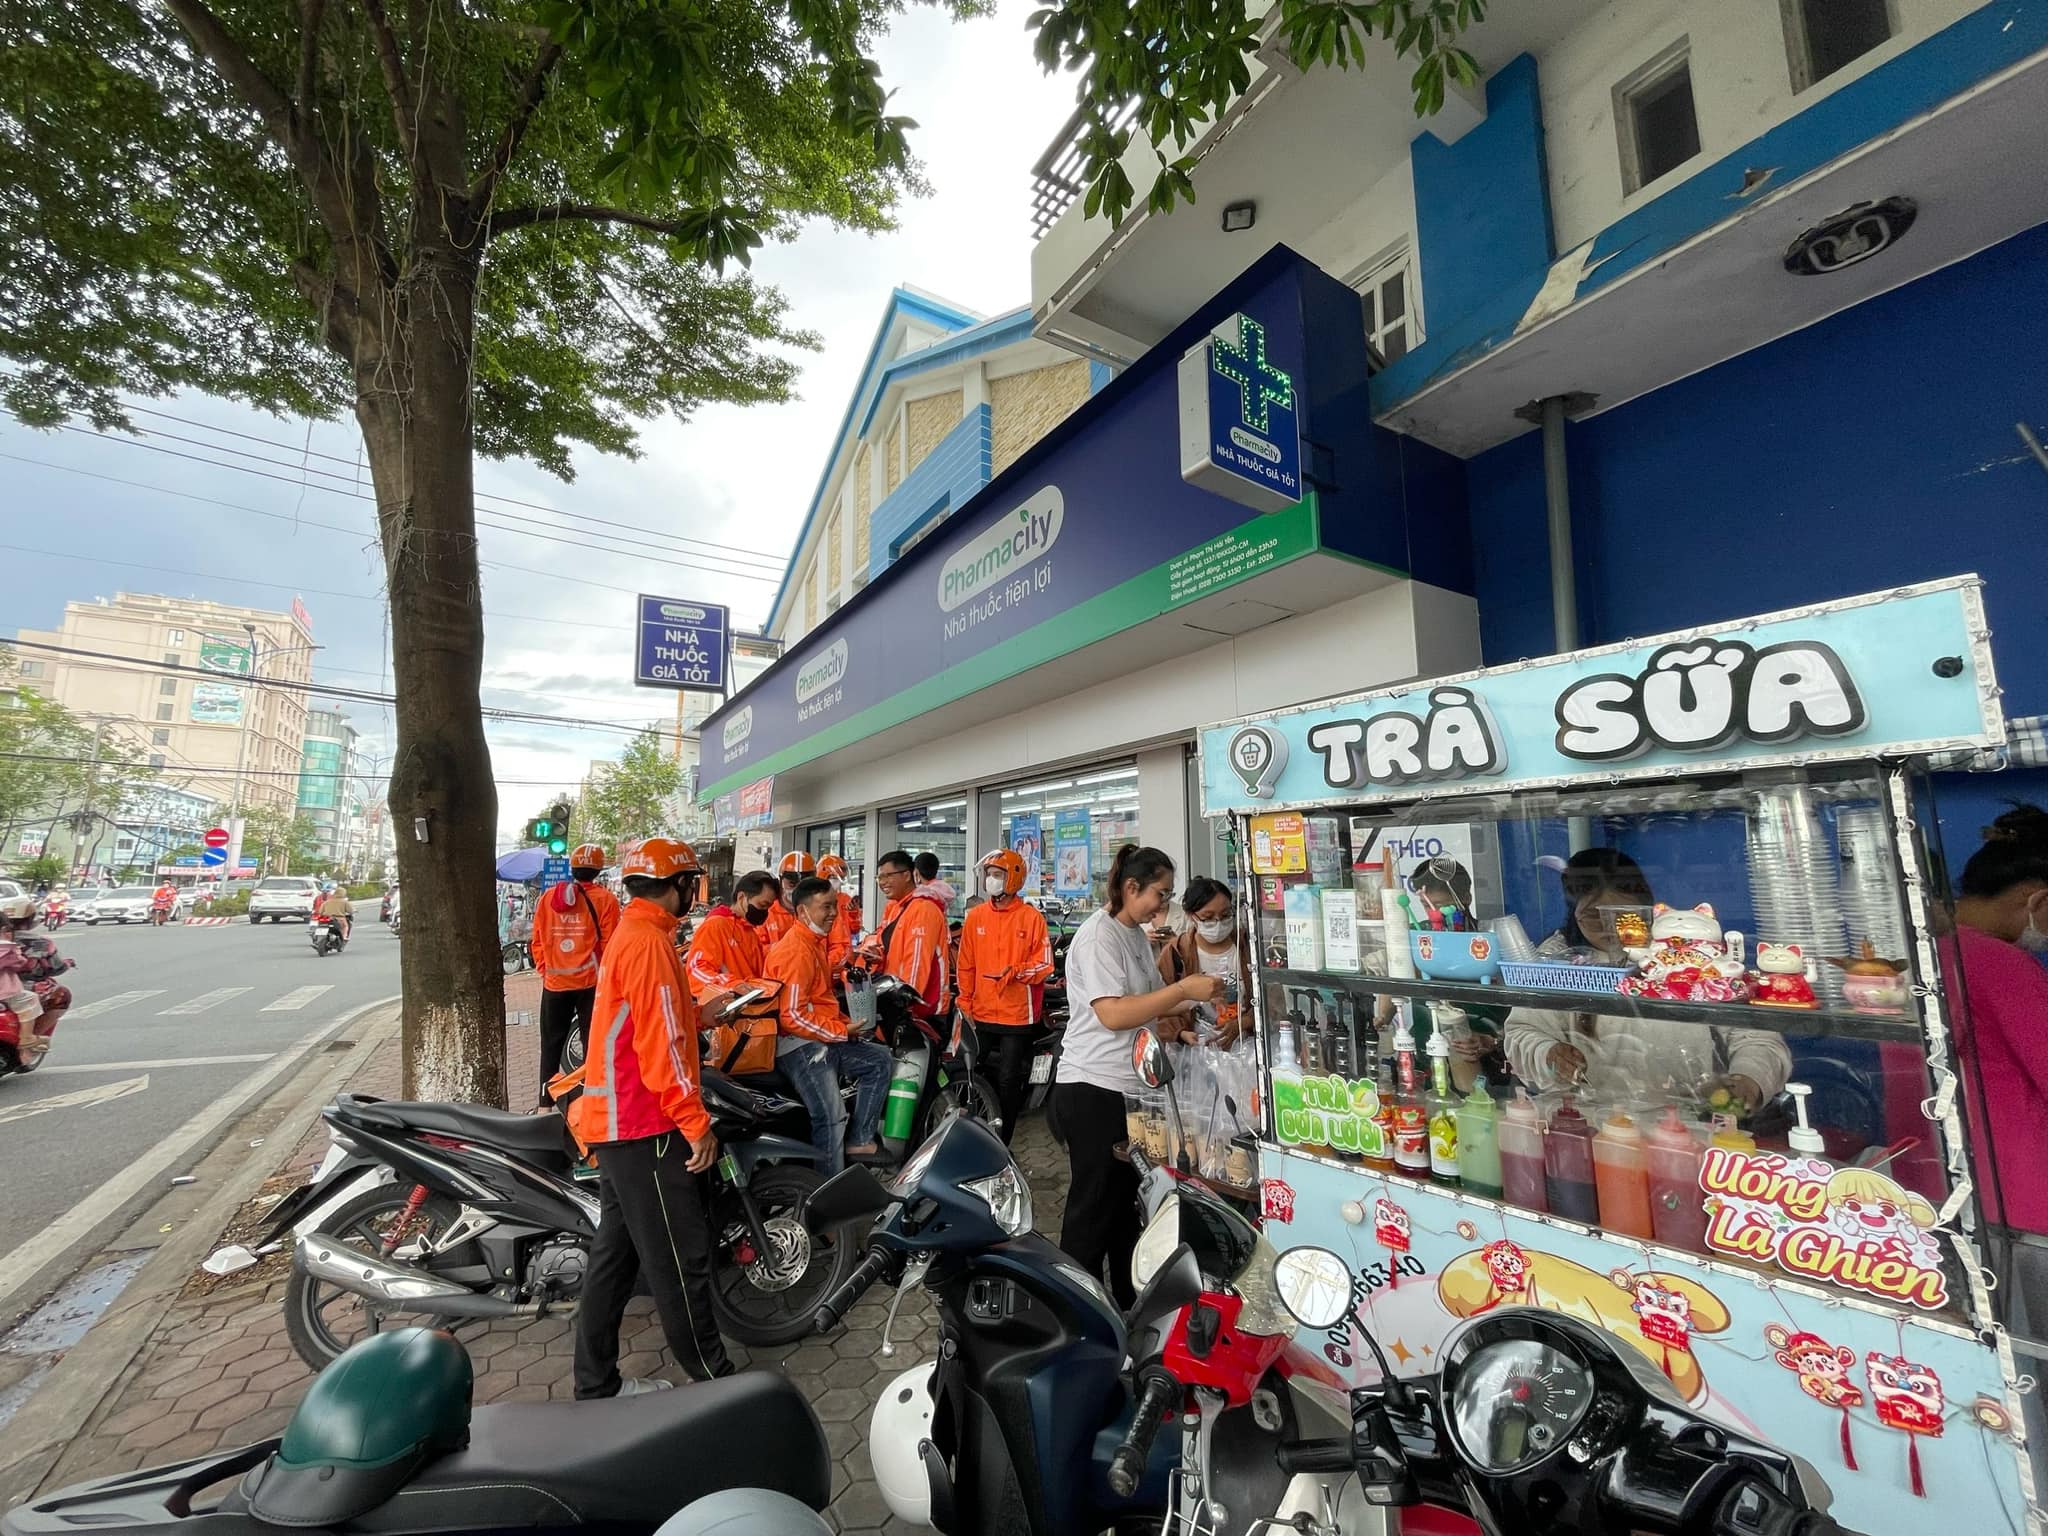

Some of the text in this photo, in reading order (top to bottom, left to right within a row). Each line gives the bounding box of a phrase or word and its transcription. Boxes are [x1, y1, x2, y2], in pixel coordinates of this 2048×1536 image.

[1216, 444, 1295, 488] NHÀ THUỐC GIÁ TỐT
[1233, 431, 1279, 462] Pharmacity
[943, 508, 1053, 602] Pharmacity
[663, 606, 703, 619] Pharmacity
[944, 560, 1052, 641] Nhà thuốc tiện lợi
[655, 645, 709, 664] THUỐC
[665, 629, 699, 645] NHÀ
[651, 664, 711, 682] GIÁ TỐT
[798, 648, 844, 697] Pharmacity
[1308, 639, 1863, 788] TRÀ SỮA
[1387, 838, 1443, 858] THEO
[1303, 1076, 1349, 1111] TRÀ
[1703, 1150, 1828, 1223] Uống
[1707, 1206, 1946, 1307] Là Ghiền
